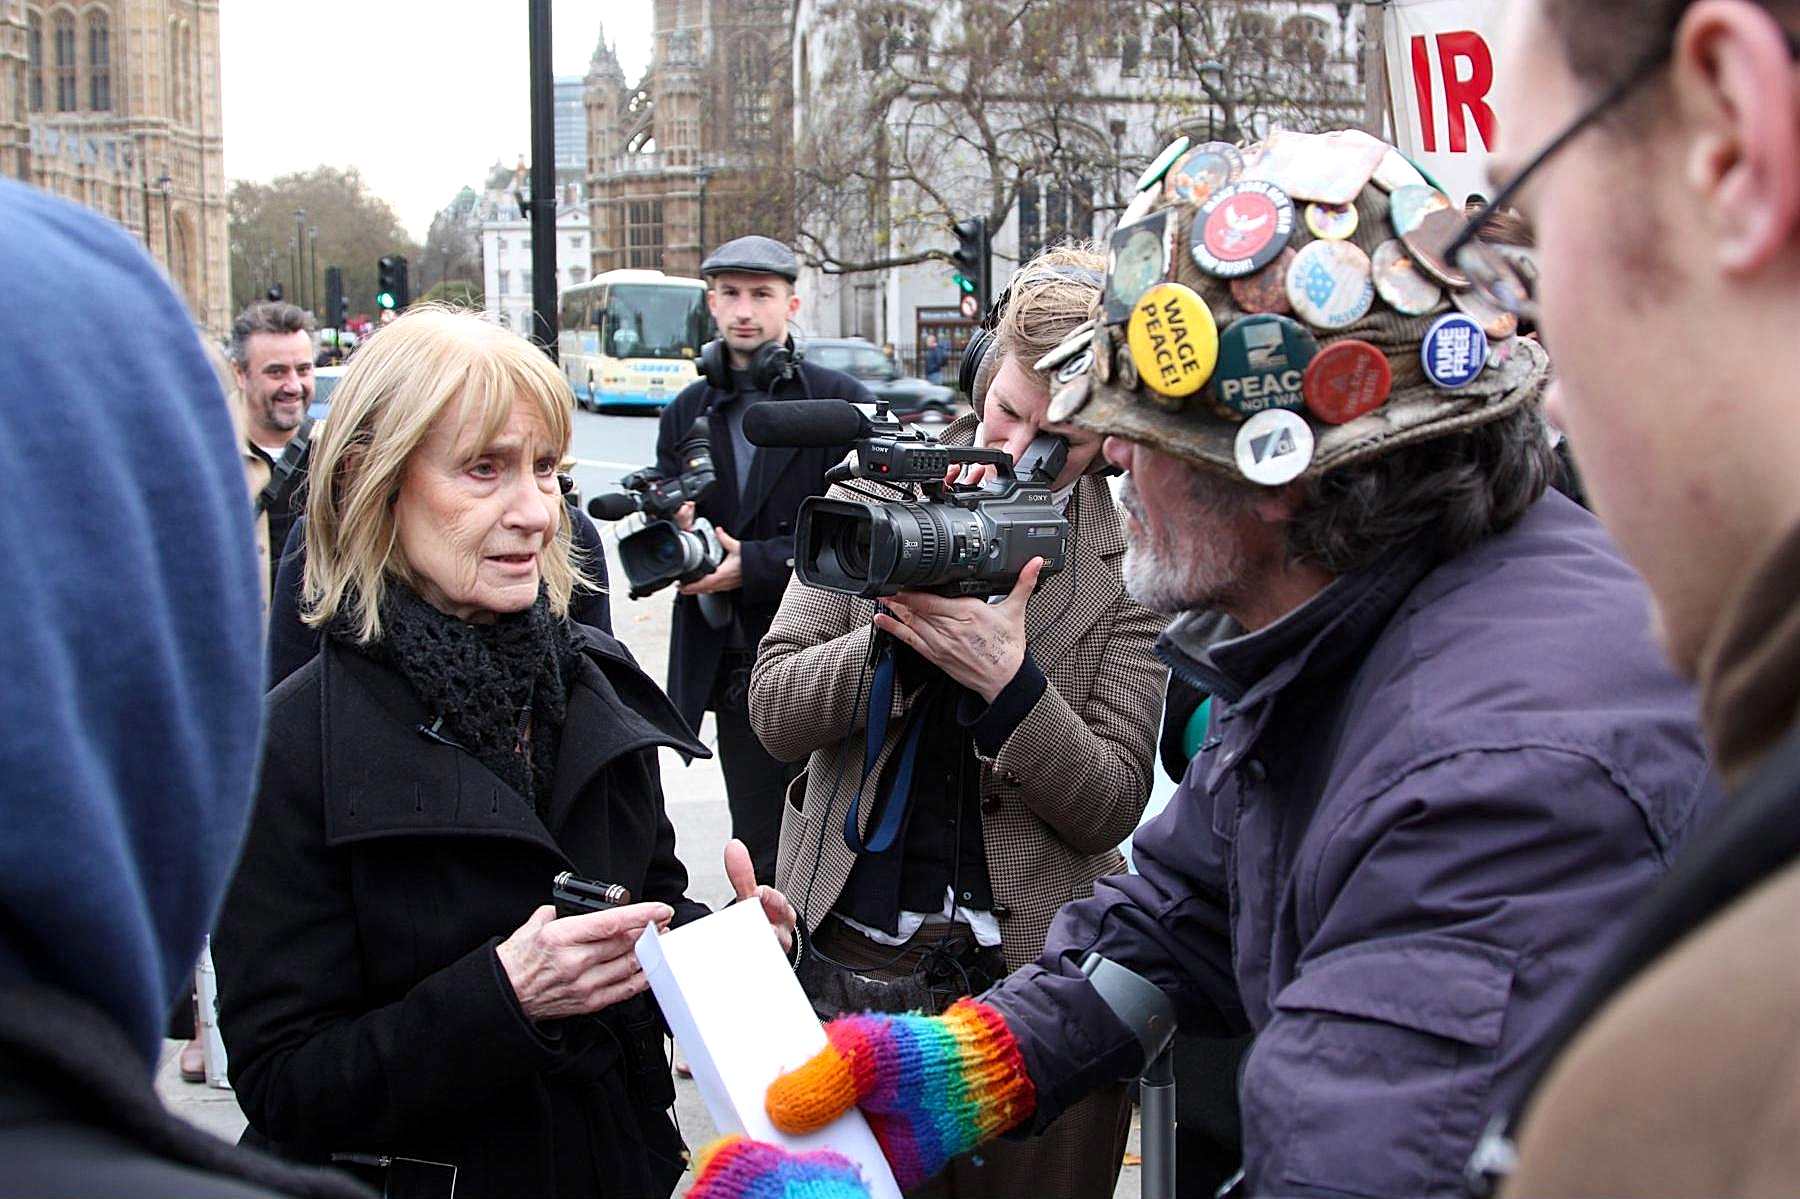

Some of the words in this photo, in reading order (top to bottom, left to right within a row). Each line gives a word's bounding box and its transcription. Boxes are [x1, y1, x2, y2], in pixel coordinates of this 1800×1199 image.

[1141, 302, 1182, 387] PEACE!
[1164, 297, 1200, 375] WAGE
[1453, 326, 1471, 377] FREE
[1222, 370, 1303, 400] PEAC
[1241, 397, 1270, 411] NOT
[871, 444, 889, 453] SONY
[1028, 494, 1048, 502] SONY
